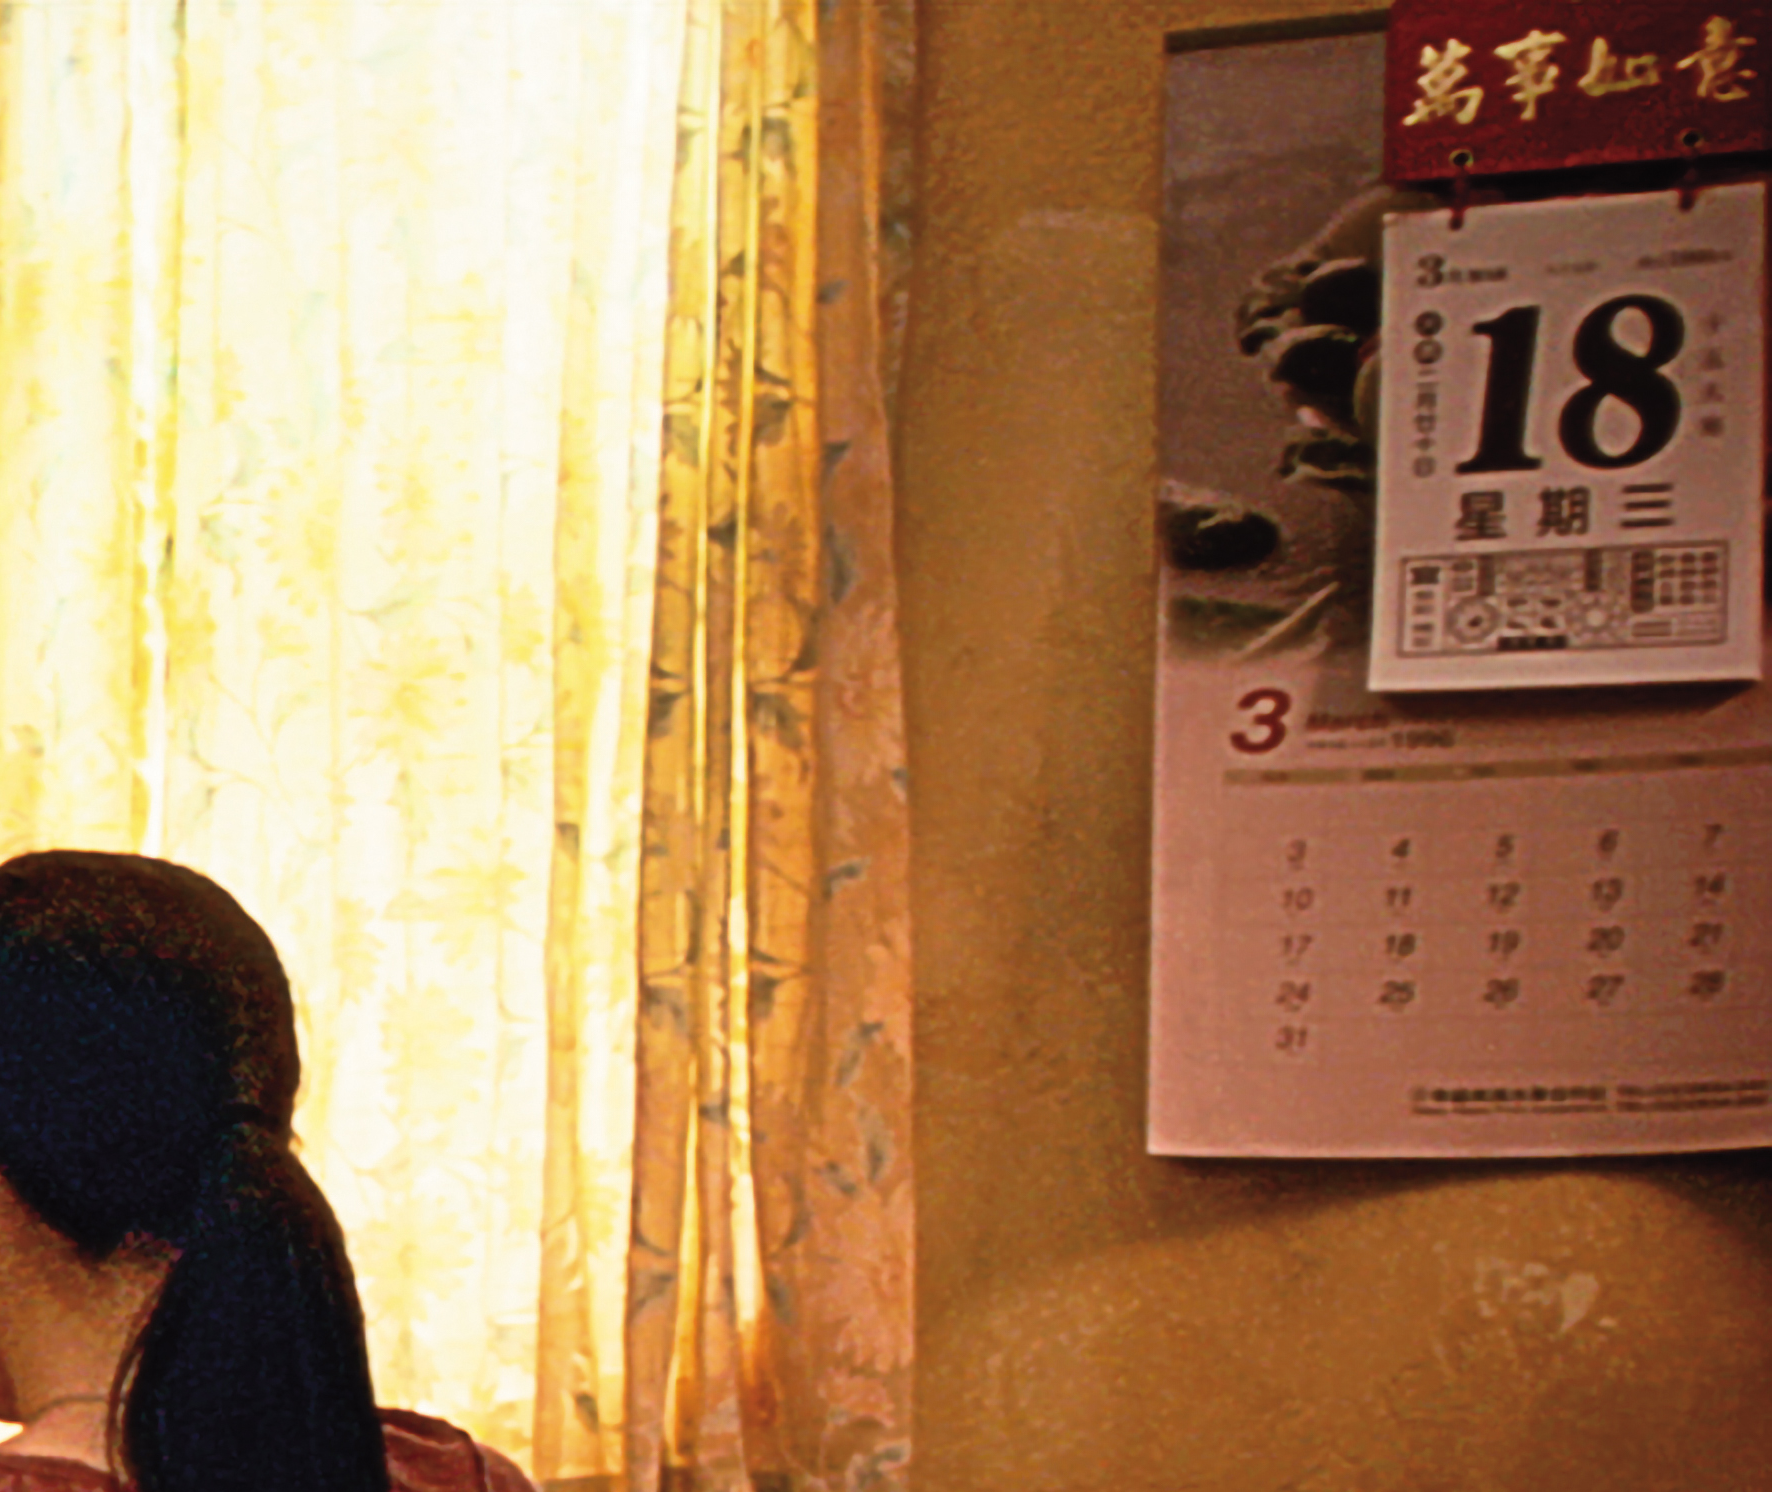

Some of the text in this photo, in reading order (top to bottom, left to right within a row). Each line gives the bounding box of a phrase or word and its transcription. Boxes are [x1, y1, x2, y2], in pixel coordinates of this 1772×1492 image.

[1402, 16, 1757, 126] 萬事如意
[1416, 255, 1446, 287] 3
[1455, 294, 1685, 474] 18
[1455, 482, 1675, 541] 星期三
[1230, 688, 1291, 754] 3
[1392, 838, 1410, 859] 4
[1496, 834, 1514, 859] 5
[1705, 823, 1724, 848] 7
[1283, 887, 1315, 911] 10
[1386, 886, 1412, 907] 11
[1489, 882, 1520, 909] 12
[1282, 934, 1313, 958] 17
[1276, 981, 1311, 1006] 24
[1379, 981, 1415, 1006] 25
[1587, 974, 1625, 1001] 27
[1276, 1026, 1307, 1051] 31
